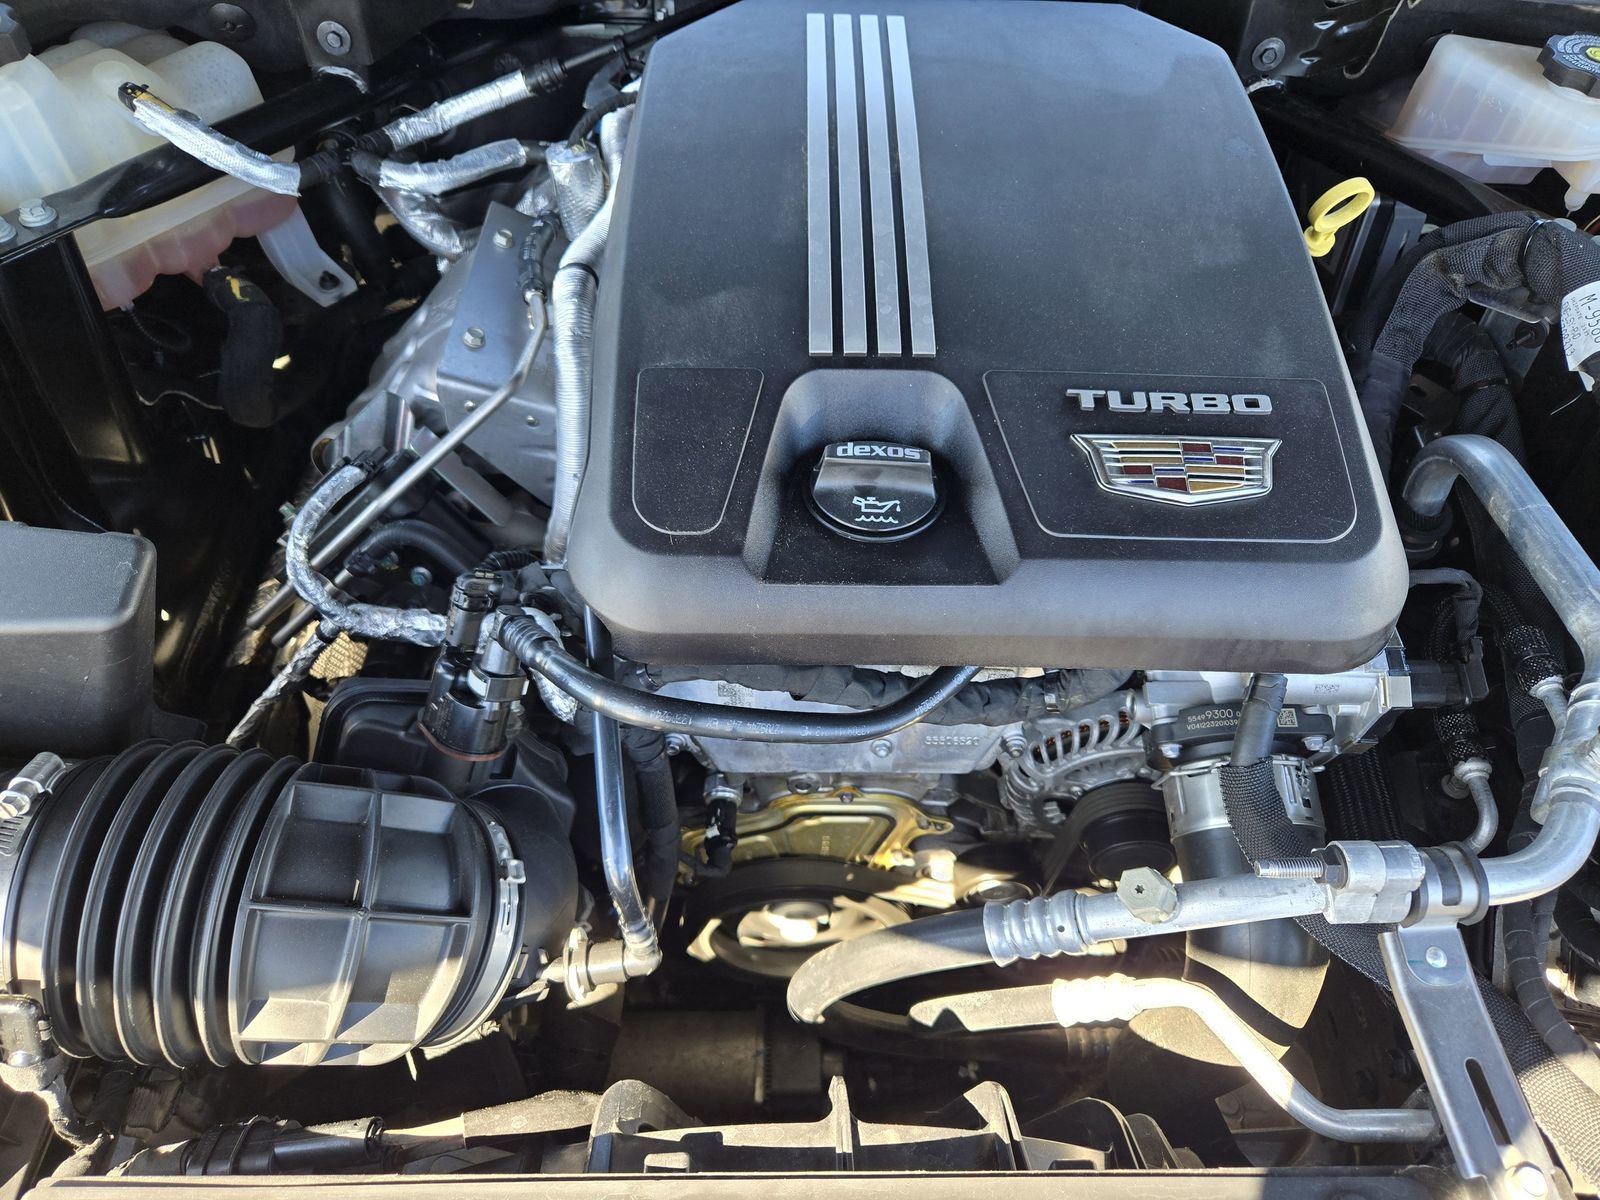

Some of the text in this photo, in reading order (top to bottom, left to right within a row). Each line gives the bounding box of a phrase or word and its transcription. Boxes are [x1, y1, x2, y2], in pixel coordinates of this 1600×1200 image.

[1066, 389, 1272, 415] TURBO
[836, 442, 923, 460] dexos
[1187, 708, 1233, 723] 55499300
